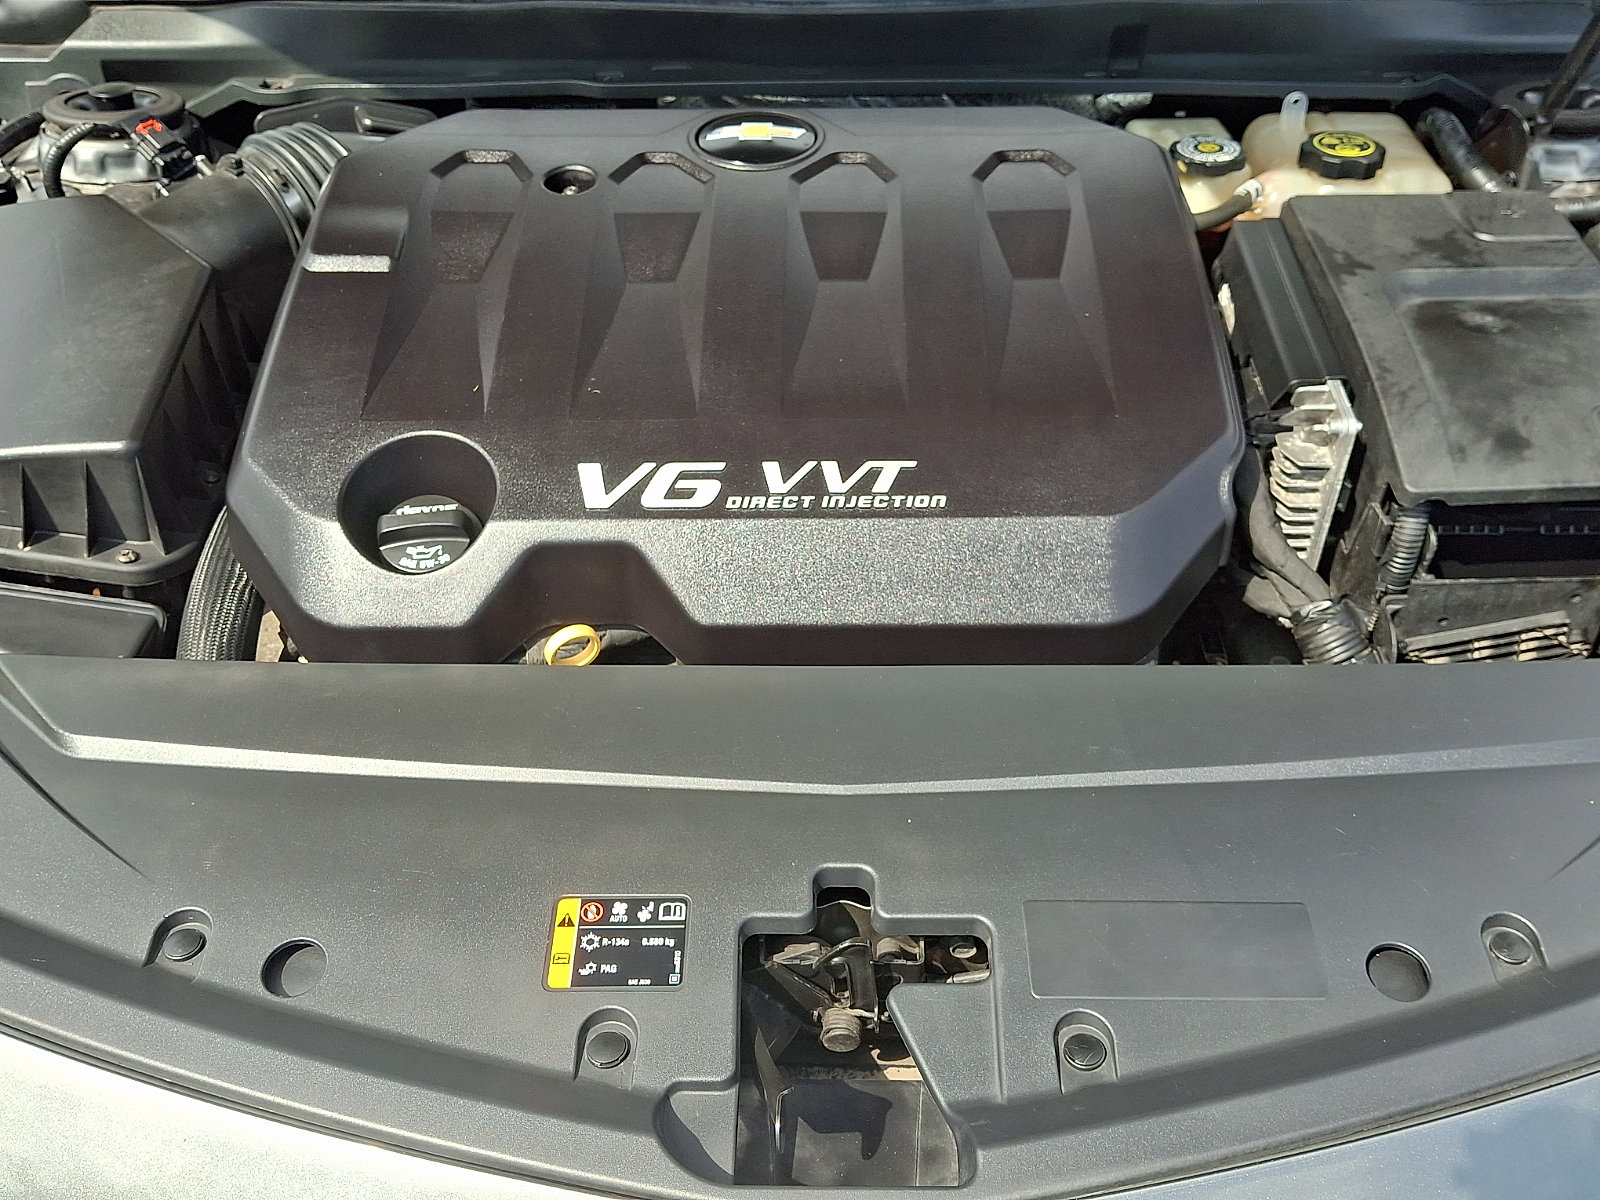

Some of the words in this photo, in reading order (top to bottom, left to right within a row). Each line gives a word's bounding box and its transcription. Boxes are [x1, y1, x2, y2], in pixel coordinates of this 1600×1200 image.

[577, 462, 727, 509] V6
[761, 460, 918, 494] VVT
[725, 494, 816, 509] DIRECT
[820, 494, 947, 509] INJECTION
[609, 915, 628, 923] AUTO
[602, 938, 630, 946] R-134a
[600, 964, 617, 973] PAG
